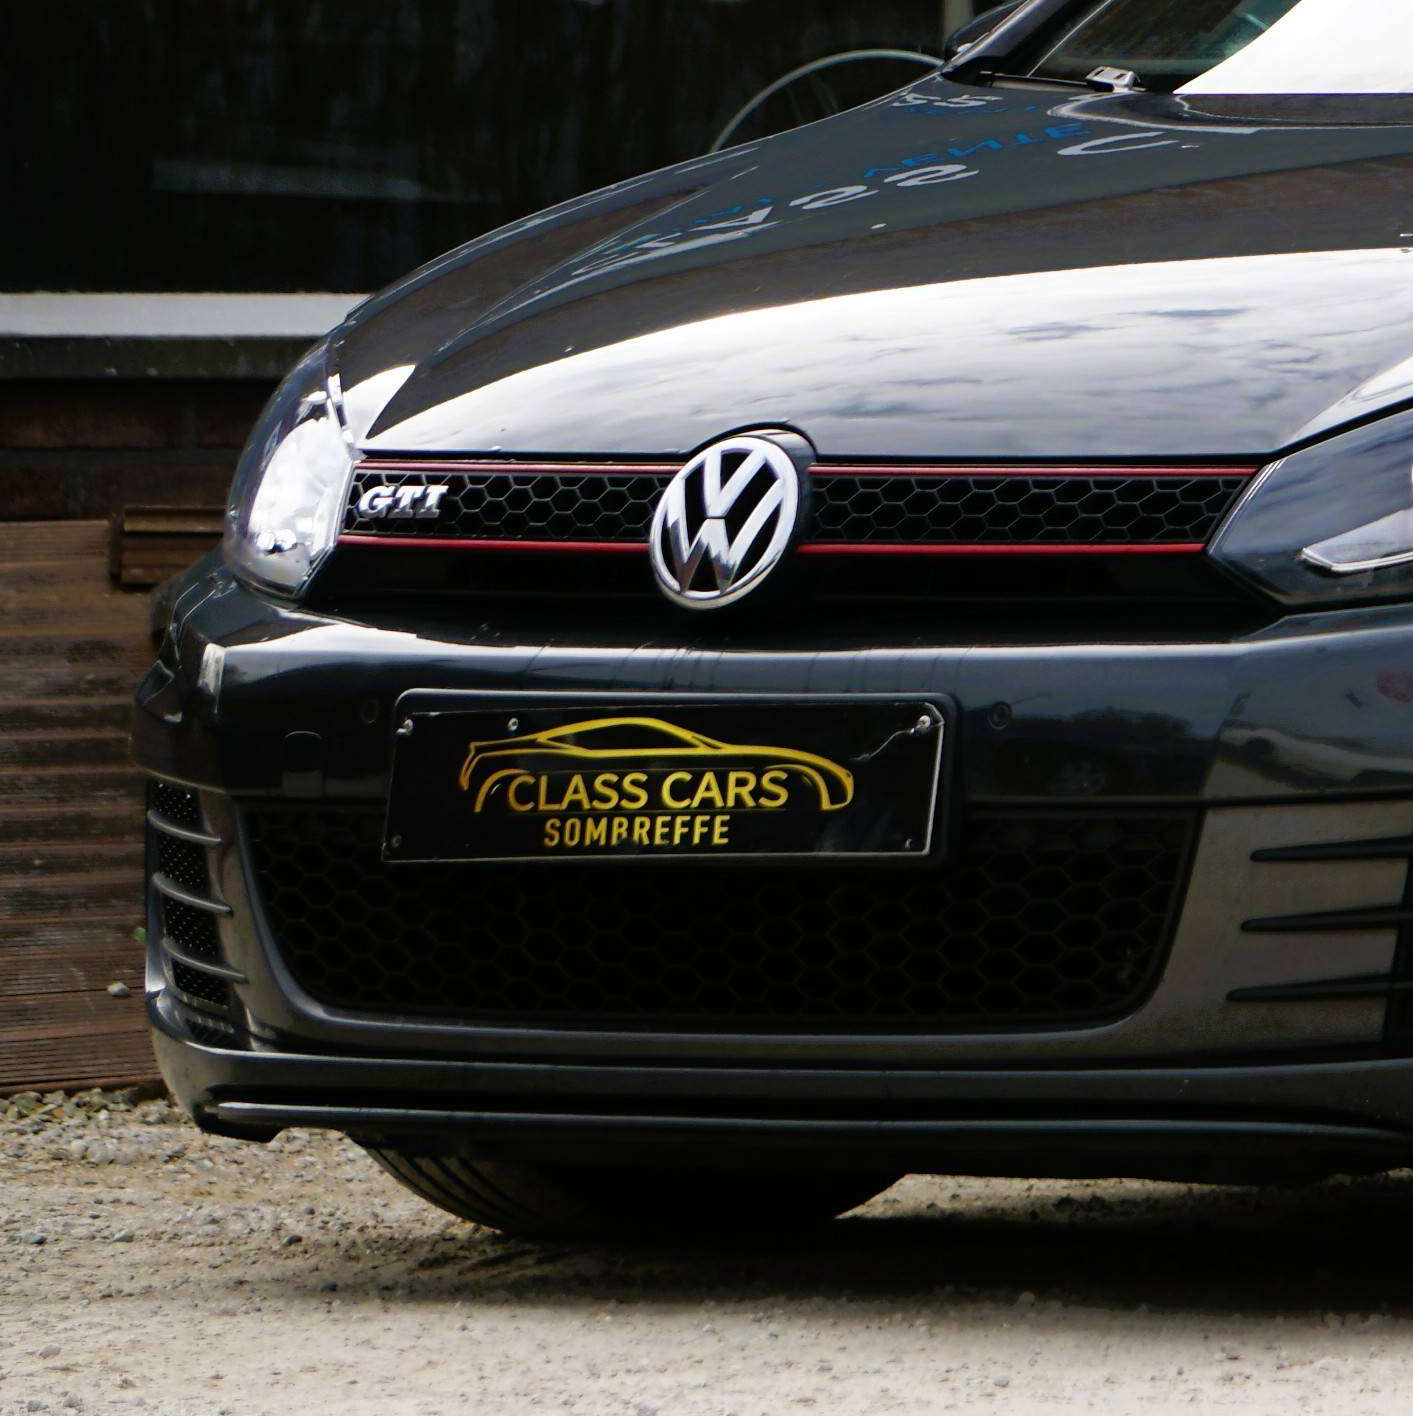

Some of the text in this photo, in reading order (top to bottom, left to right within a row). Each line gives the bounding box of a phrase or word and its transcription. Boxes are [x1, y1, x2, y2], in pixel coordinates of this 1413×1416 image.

[356, 485, 449, 518] GTI
[508, 769, 789, 811] CLASS CARS
[543, 814, 731, 847] SOMBREFFE
